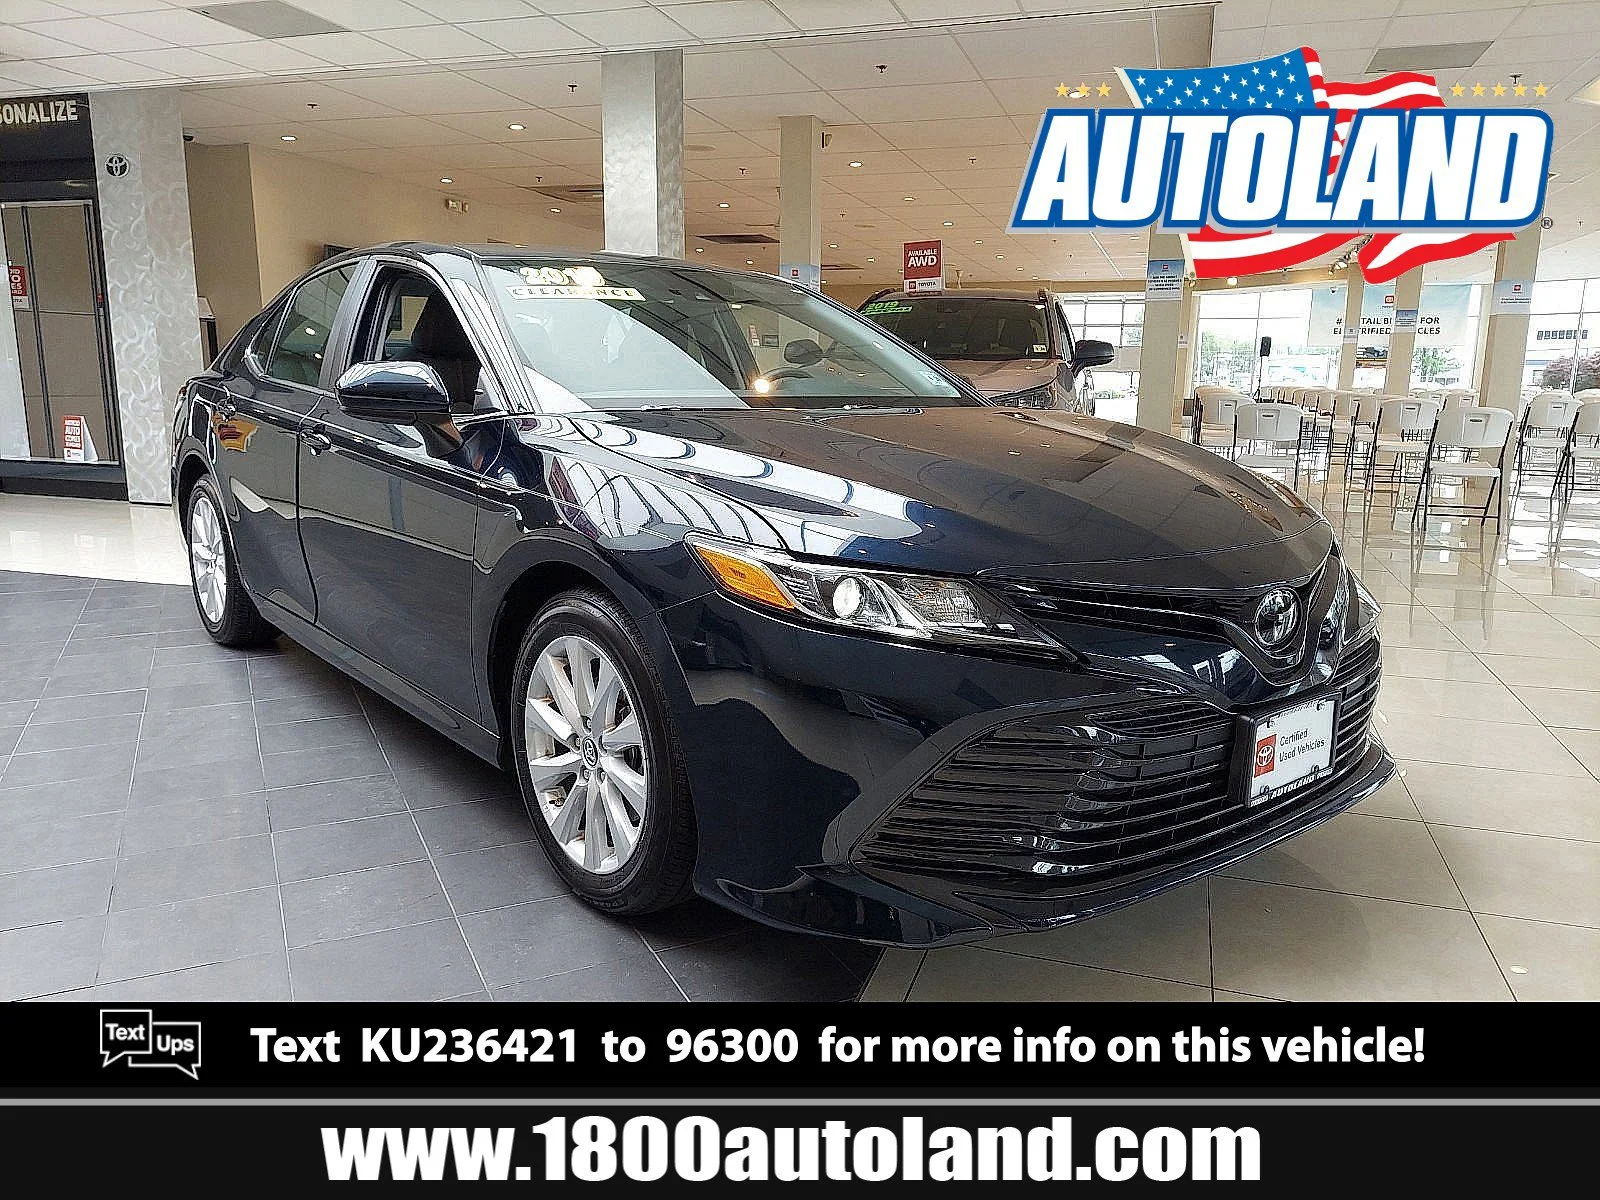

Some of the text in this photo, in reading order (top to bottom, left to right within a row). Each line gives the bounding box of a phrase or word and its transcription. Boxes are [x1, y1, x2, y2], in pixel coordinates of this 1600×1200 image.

[0, 101, 79, 124] ONALIZE
[907, 248, 938, 258] AVAILABLE
[907, 255, 938, 268] AWD
[512, 287, 637, 297] CLEANCE
[1360, 317, 1382, 325] TAIL
[1420, 316, 1440, 325] FOR
[1417, 326, 1441, 335] CLES
[1280, 728, 1308, 746] Certified
[1279, 739, 1325, 762] Used Vehicles
